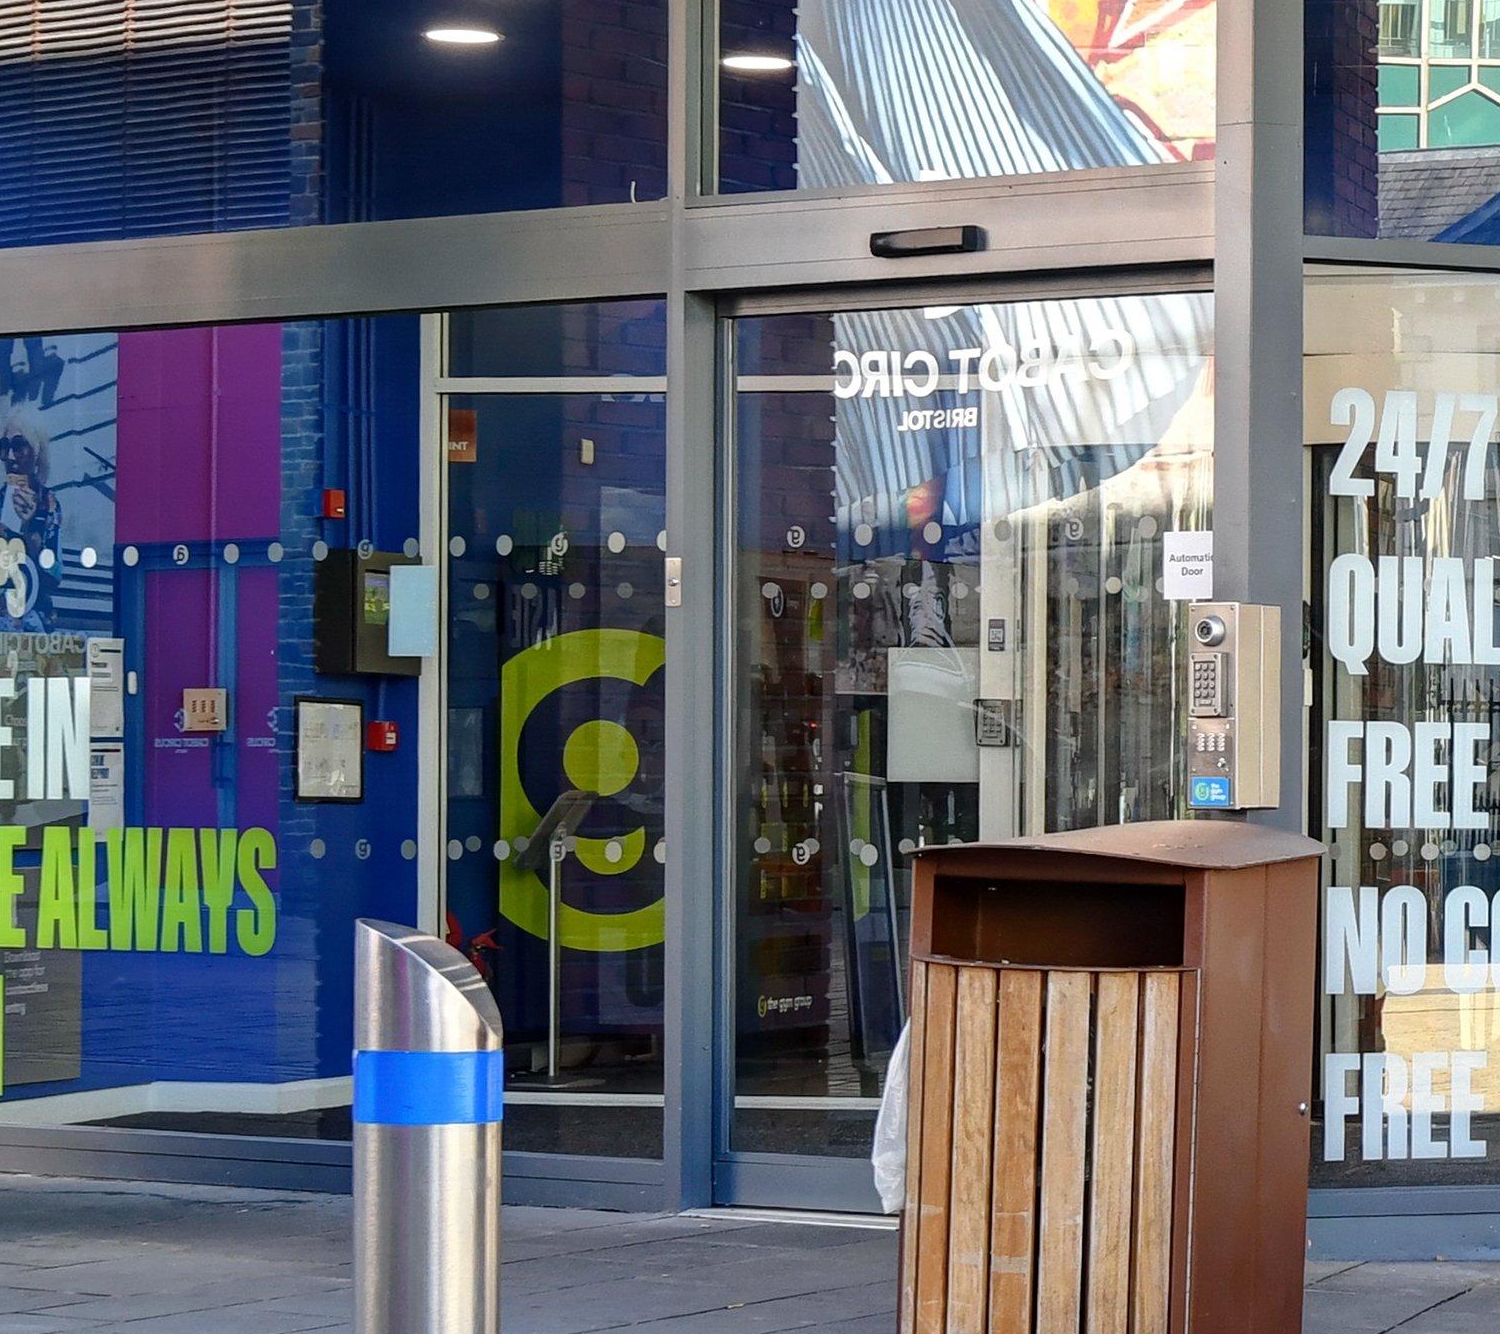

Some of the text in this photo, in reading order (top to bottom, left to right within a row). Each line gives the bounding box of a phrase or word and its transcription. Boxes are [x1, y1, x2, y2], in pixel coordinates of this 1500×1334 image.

[1181, 566, 1204, 576] Door
[27, 677, 91, 800] IN
[1326, 720, 1489, 829] FREE
[36, 825, 277, 957] ALWAYS
[1325, 887, 1429, 995] NO
[1324, 1052, 1488, 1161] FREE
